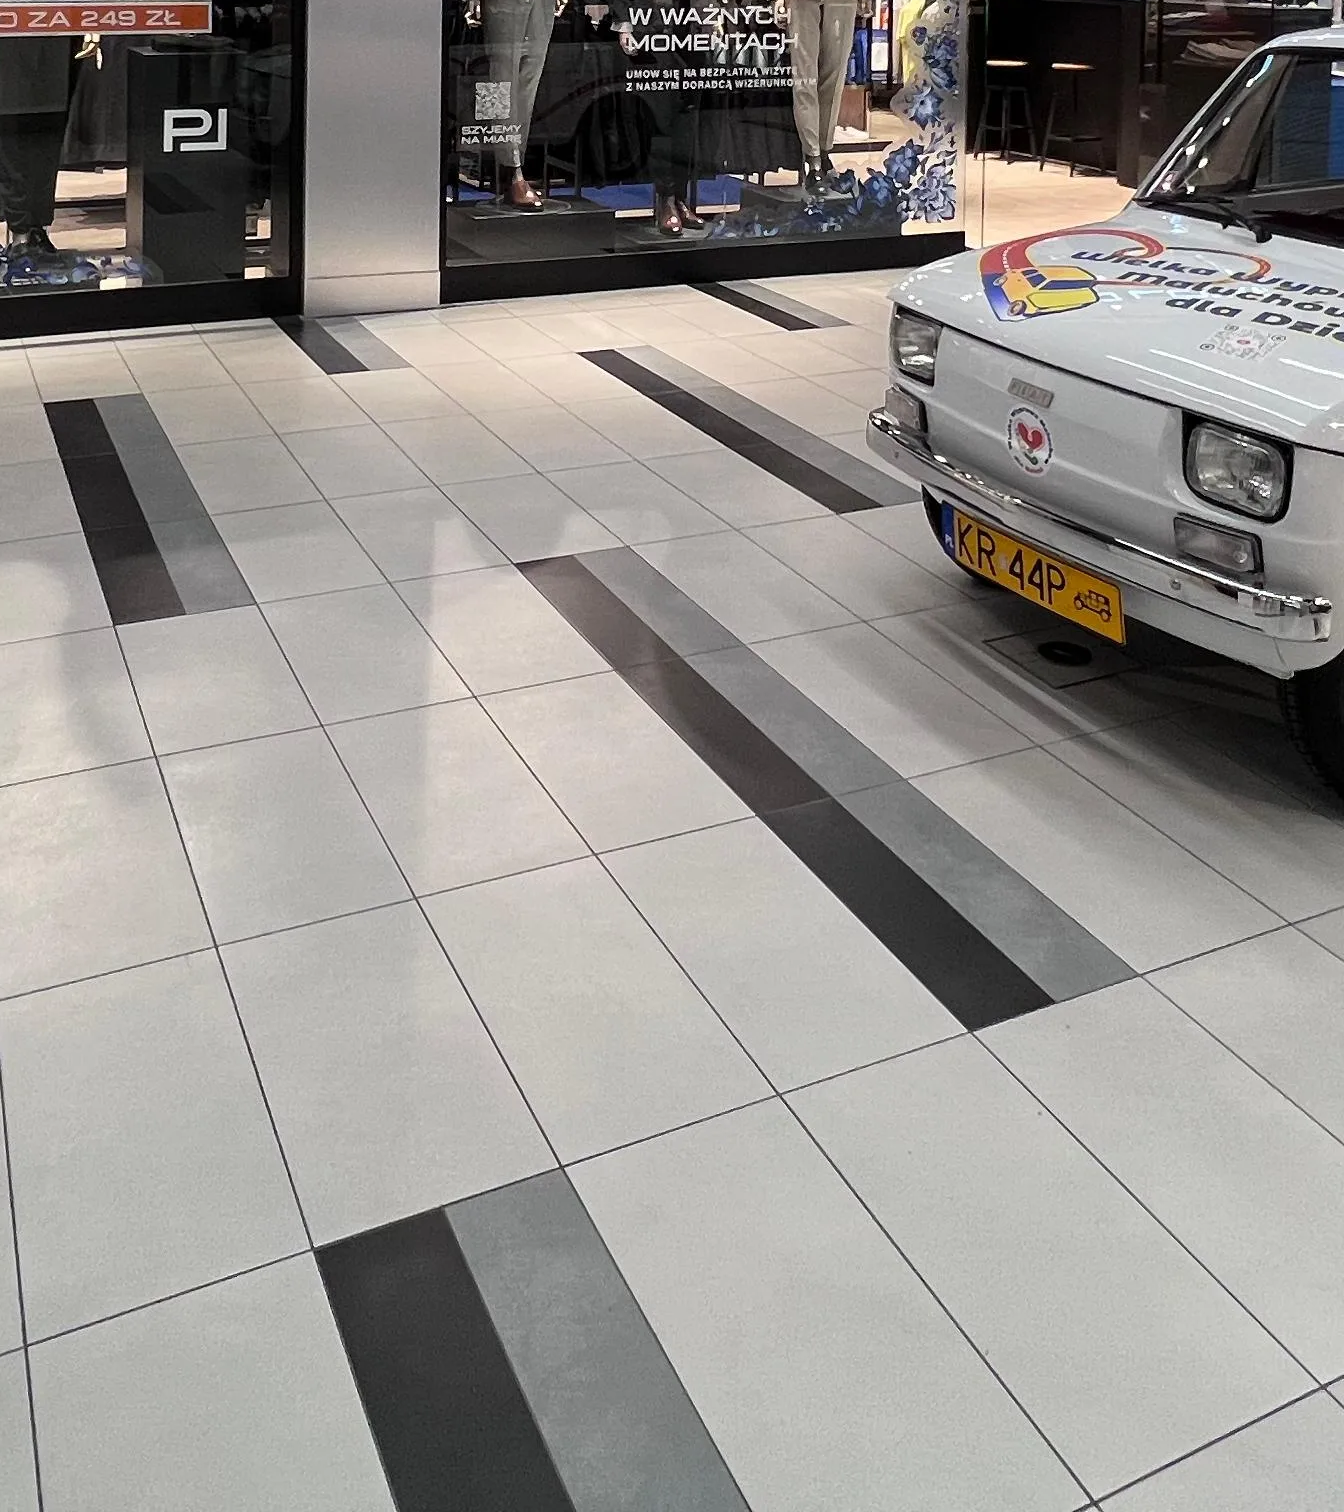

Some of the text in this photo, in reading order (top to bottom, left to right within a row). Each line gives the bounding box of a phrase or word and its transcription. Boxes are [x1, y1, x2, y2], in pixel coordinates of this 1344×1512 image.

[27, 10, 71, 28] ZA
[80, 9, 137, 27] 249
[145, 9, 182, 26] ZŁ
[628, 3, 792, 26] W WAŻNYCH
[627, 32, 800, 52] MOMENTACH
[625, 82, 633, 92] Z
[461, 135, 480, 145] NA
[1164, 295, 1242, 319] dla
[957, 517, 1066, 605] KR 44P
